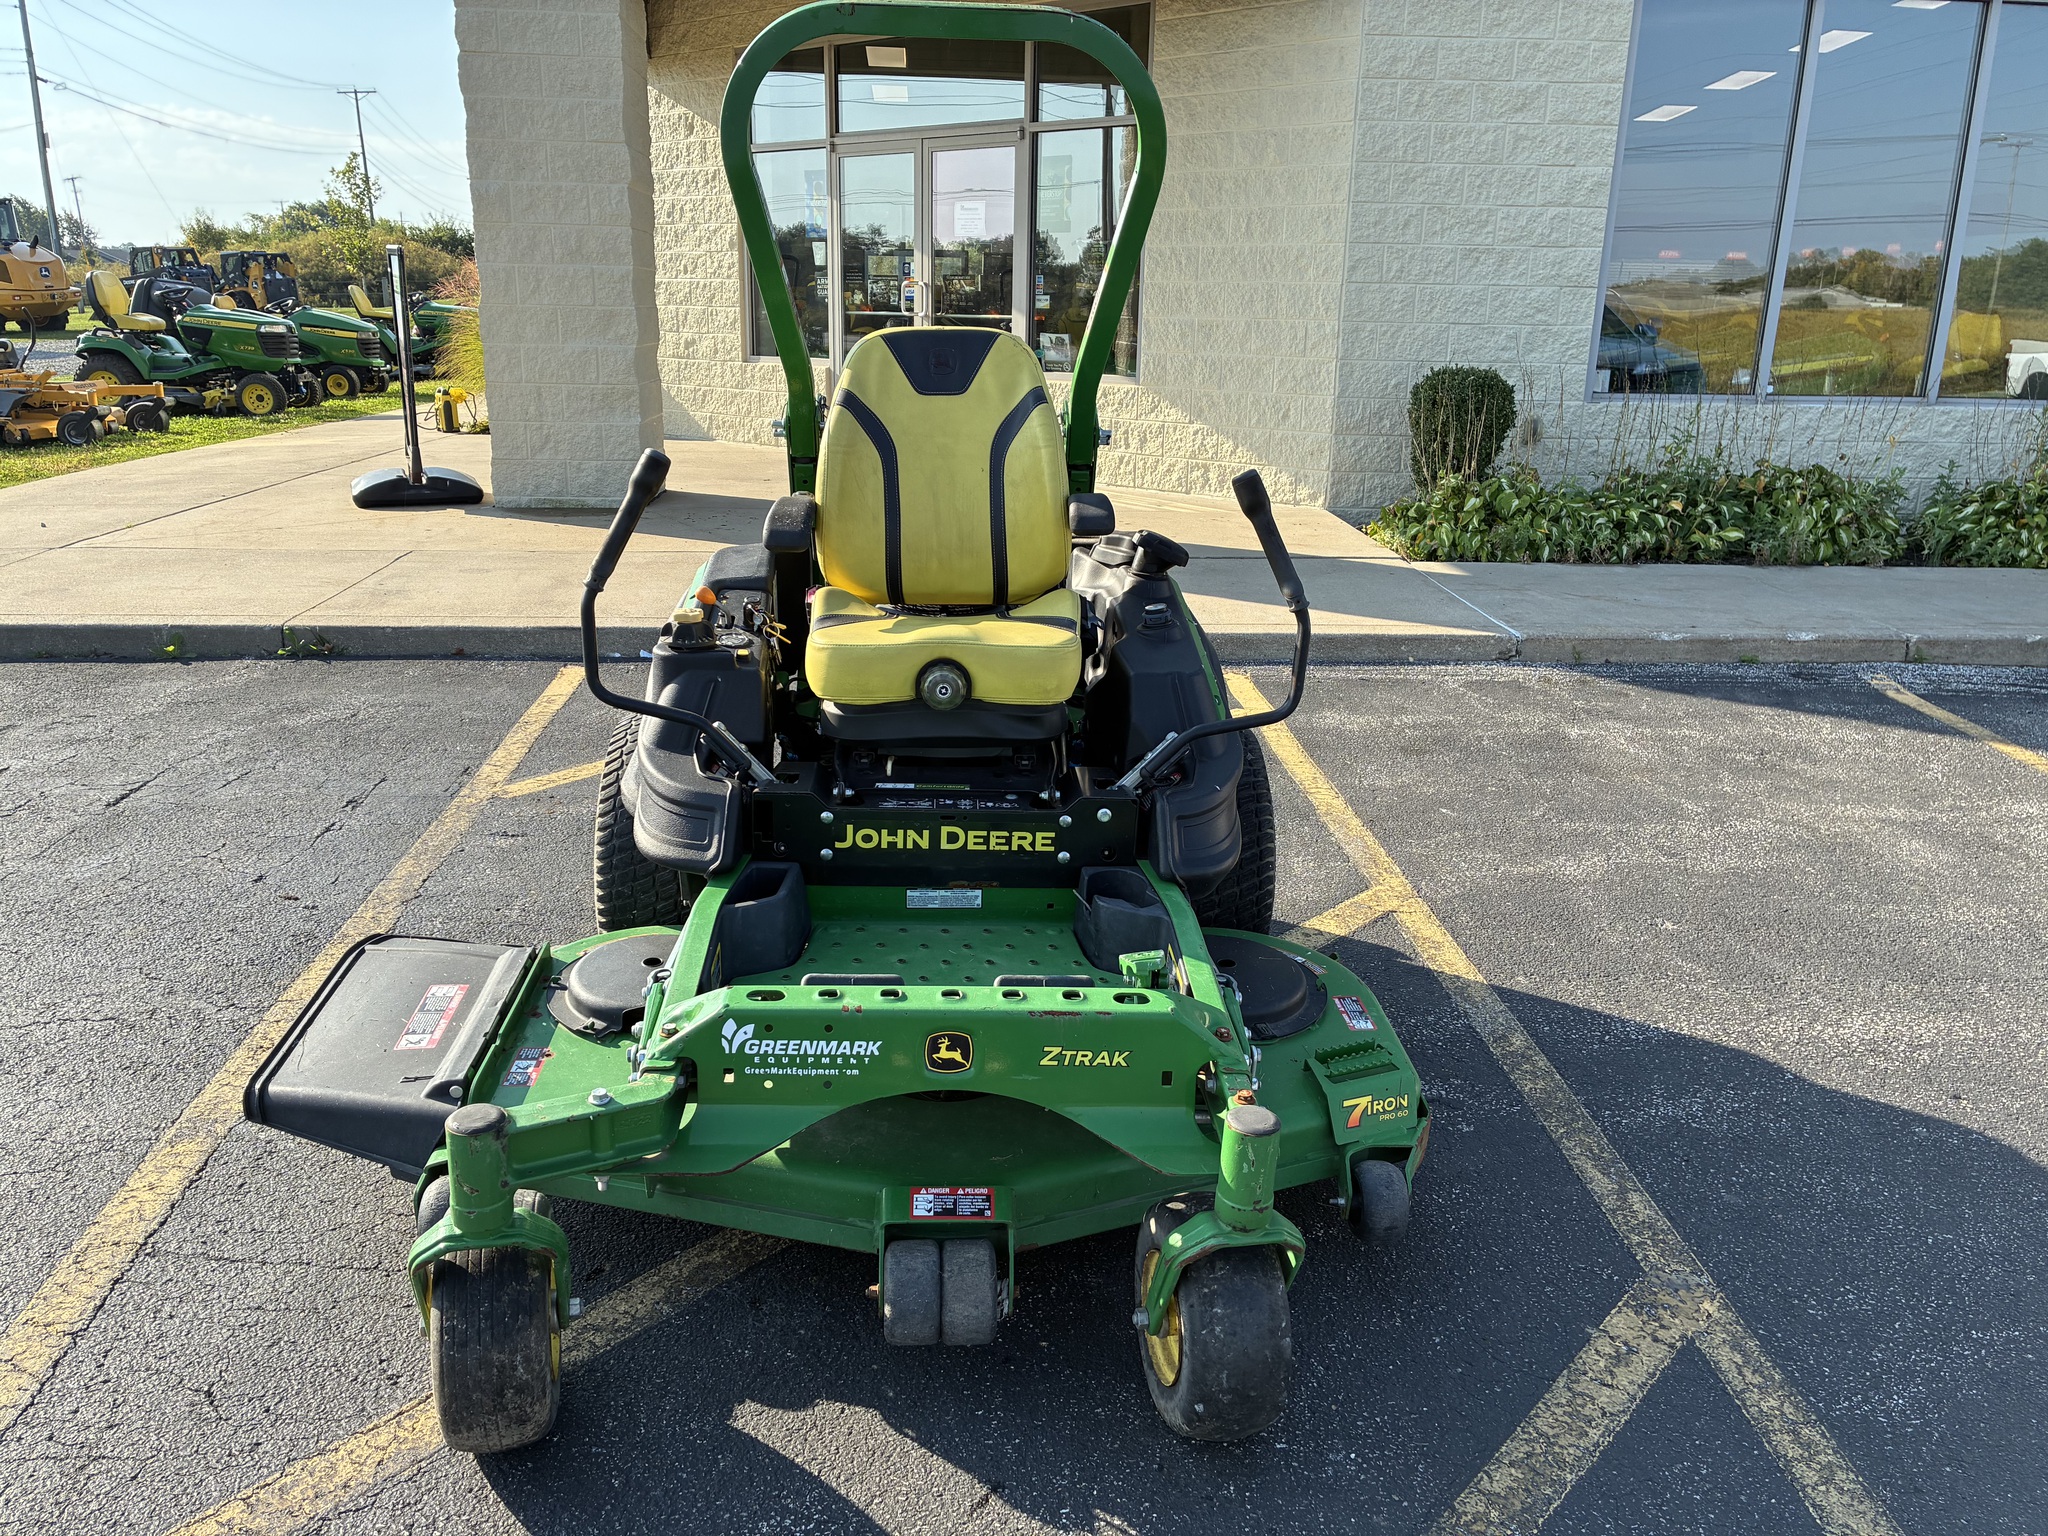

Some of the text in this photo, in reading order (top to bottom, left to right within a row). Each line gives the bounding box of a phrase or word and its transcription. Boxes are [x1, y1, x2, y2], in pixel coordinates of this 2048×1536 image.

[835, 824, 1056, 852] JOHN DEERE
[744, 1040, 883, 1056] GREENMARK
[744, 1066, 859, 1076] GreenMarkEquipmentom
[1379, 1109, 1408, 1122] PRO 60
